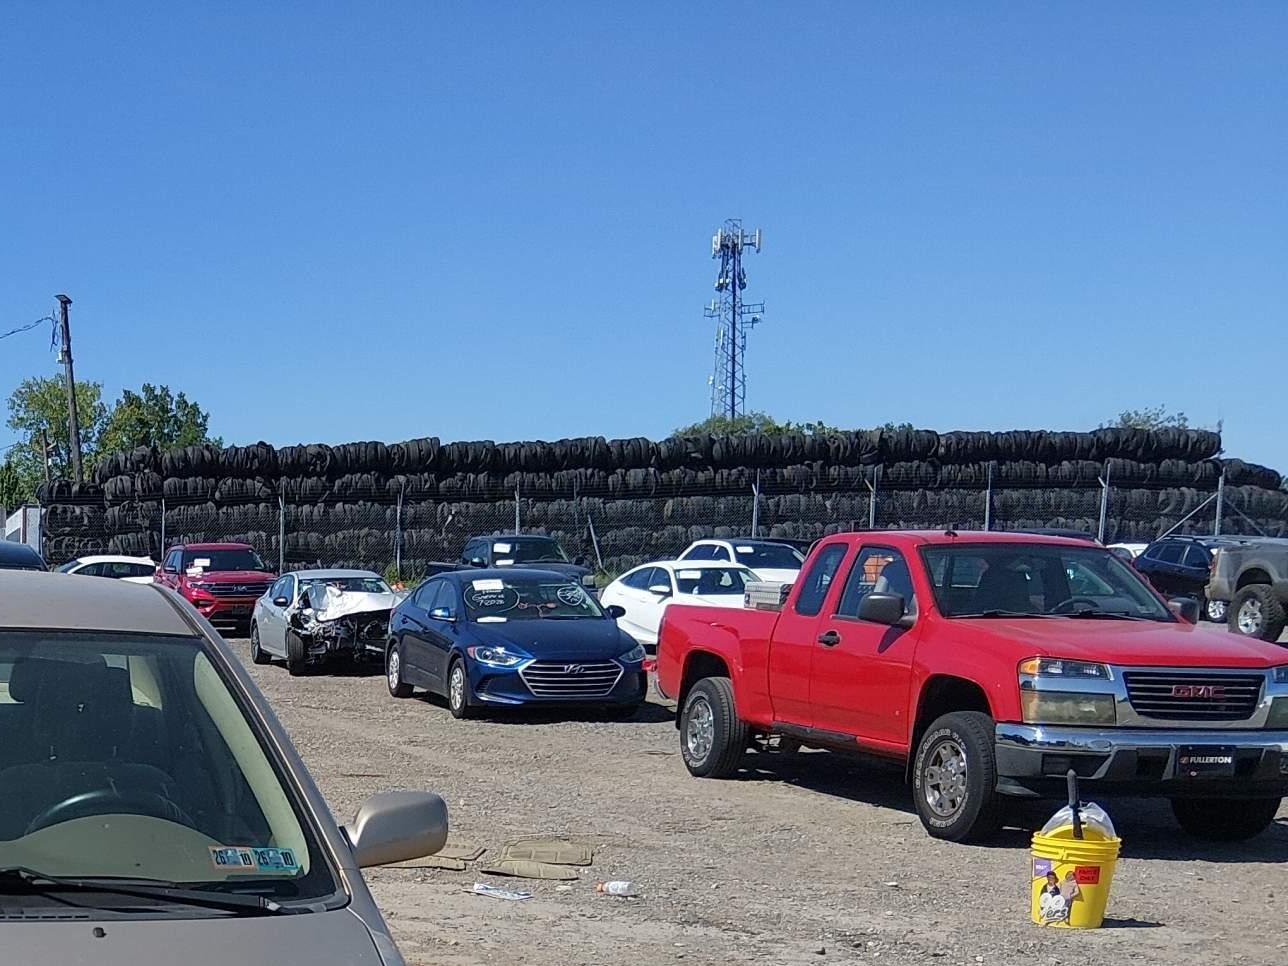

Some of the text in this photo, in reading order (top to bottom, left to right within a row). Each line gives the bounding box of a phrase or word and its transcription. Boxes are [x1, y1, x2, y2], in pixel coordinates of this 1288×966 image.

[1172, 685, 1225, 698] GMC
[1189, 756, 1232, 764] FULLERTON
[214, 849, 253, 866] 26 10
[255, 849, 293, 866] 26 10
